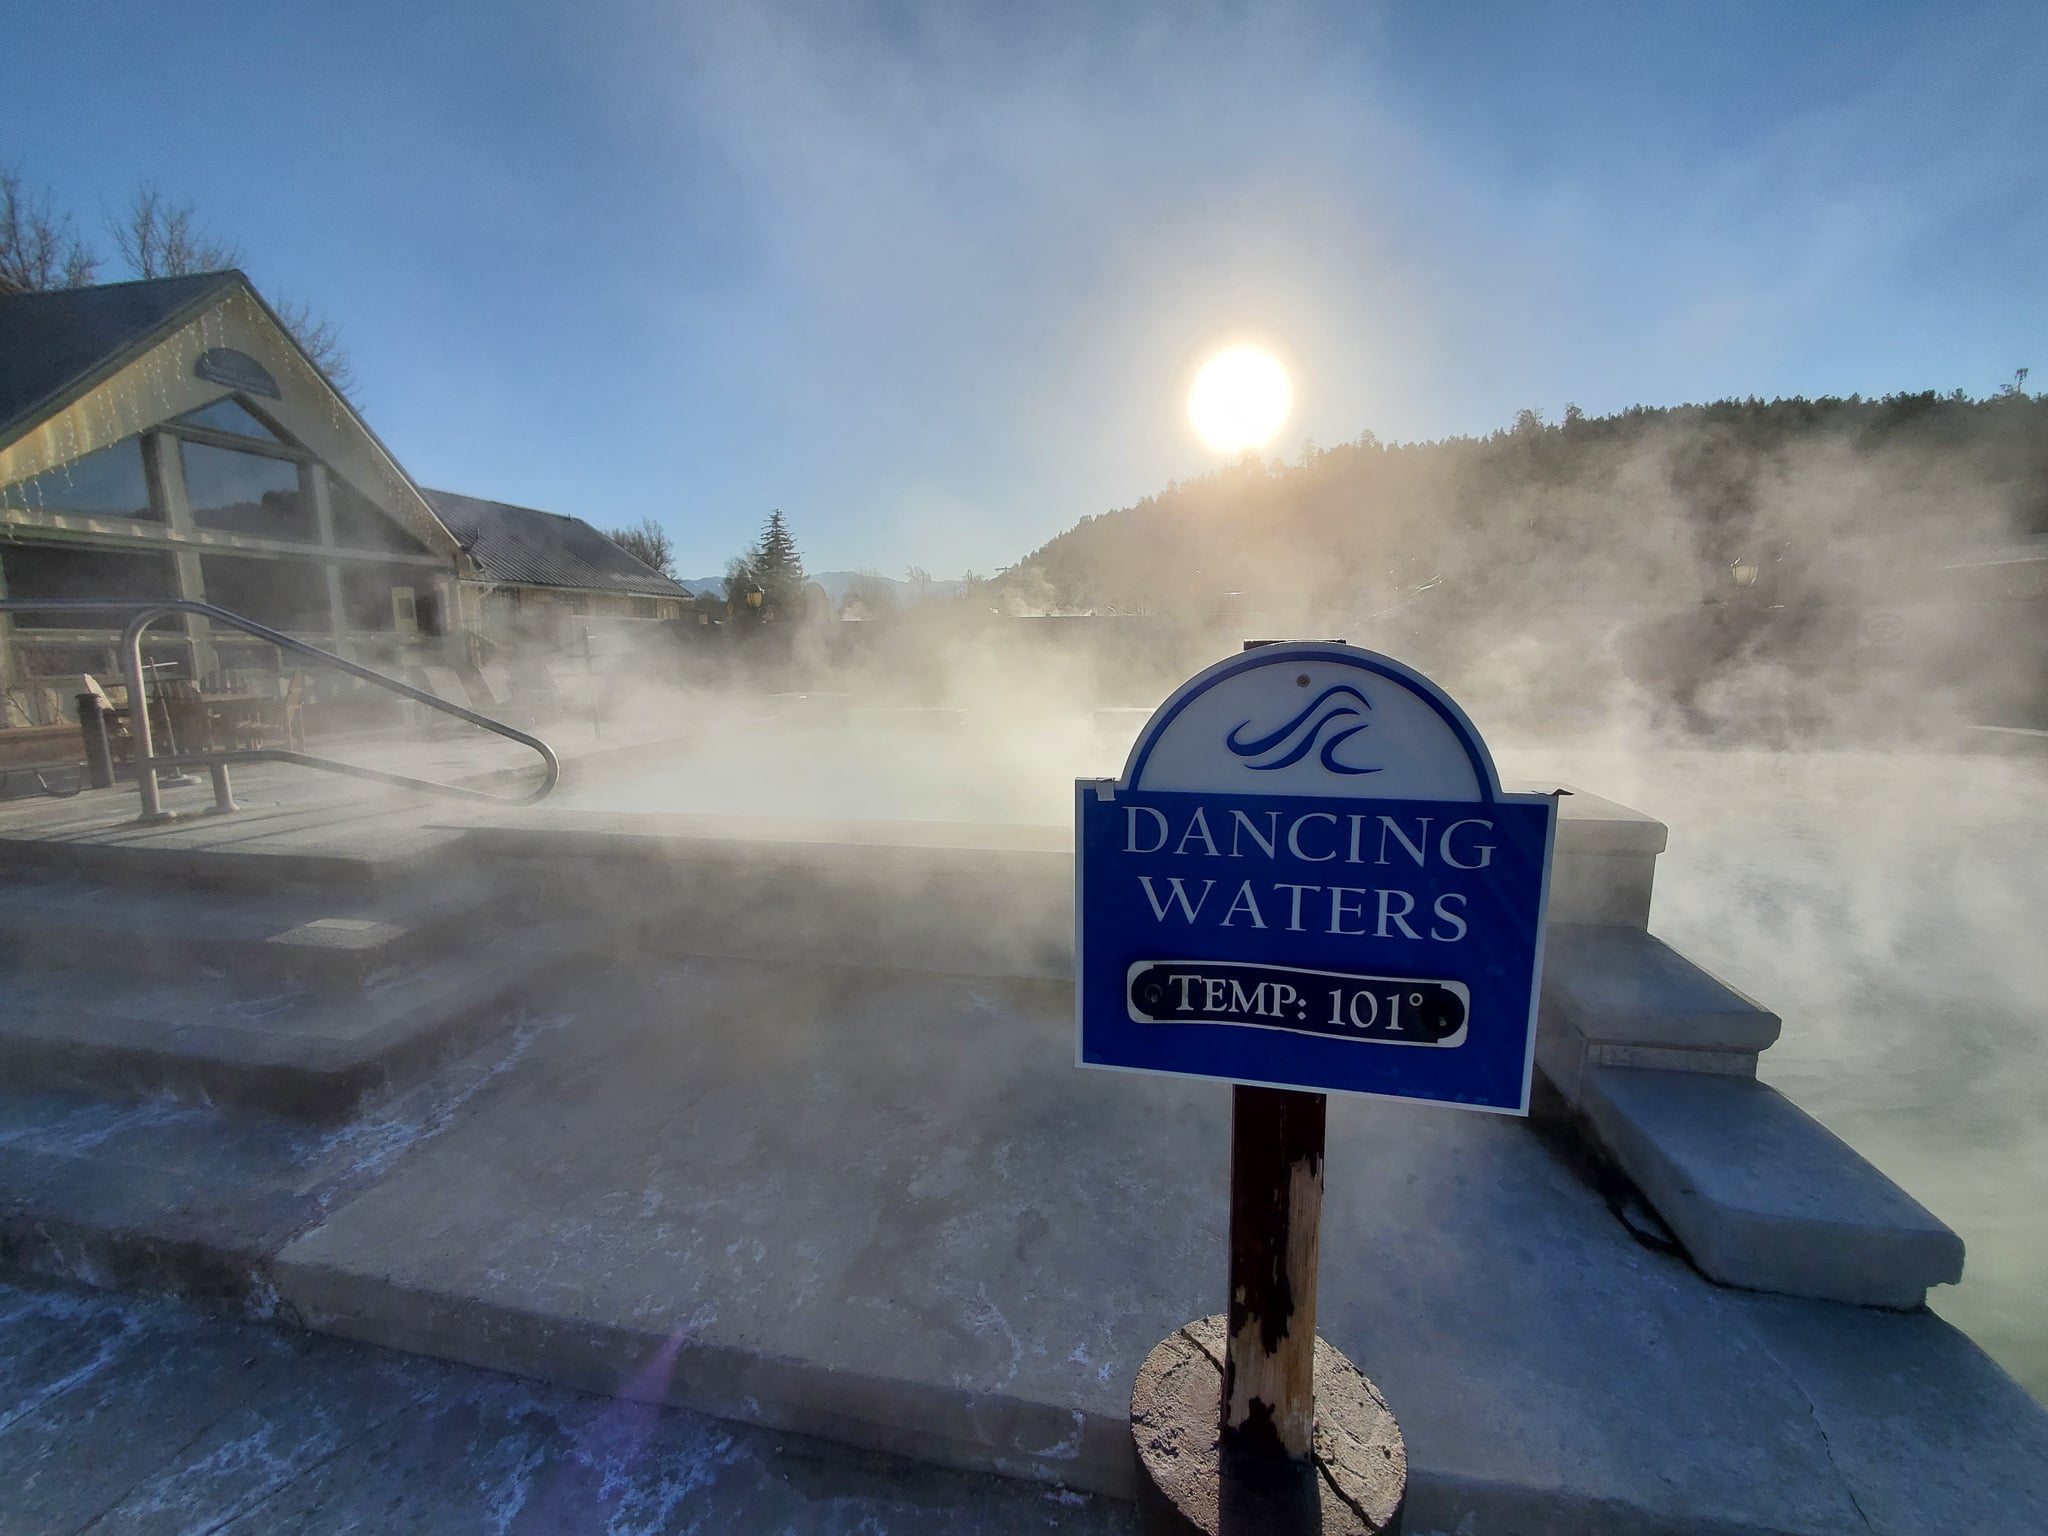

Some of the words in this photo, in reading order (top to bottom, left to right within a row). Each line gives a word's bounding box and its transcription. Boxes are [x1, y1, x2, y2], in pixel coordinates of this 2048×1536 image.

[1122, 806, 1497, 869] DANCING
[1137, 876, 1468, 942] WATERS
[1168, 974, 1307, 1020] TEMP:
[1328, 990, 1424, 1031] 101°
